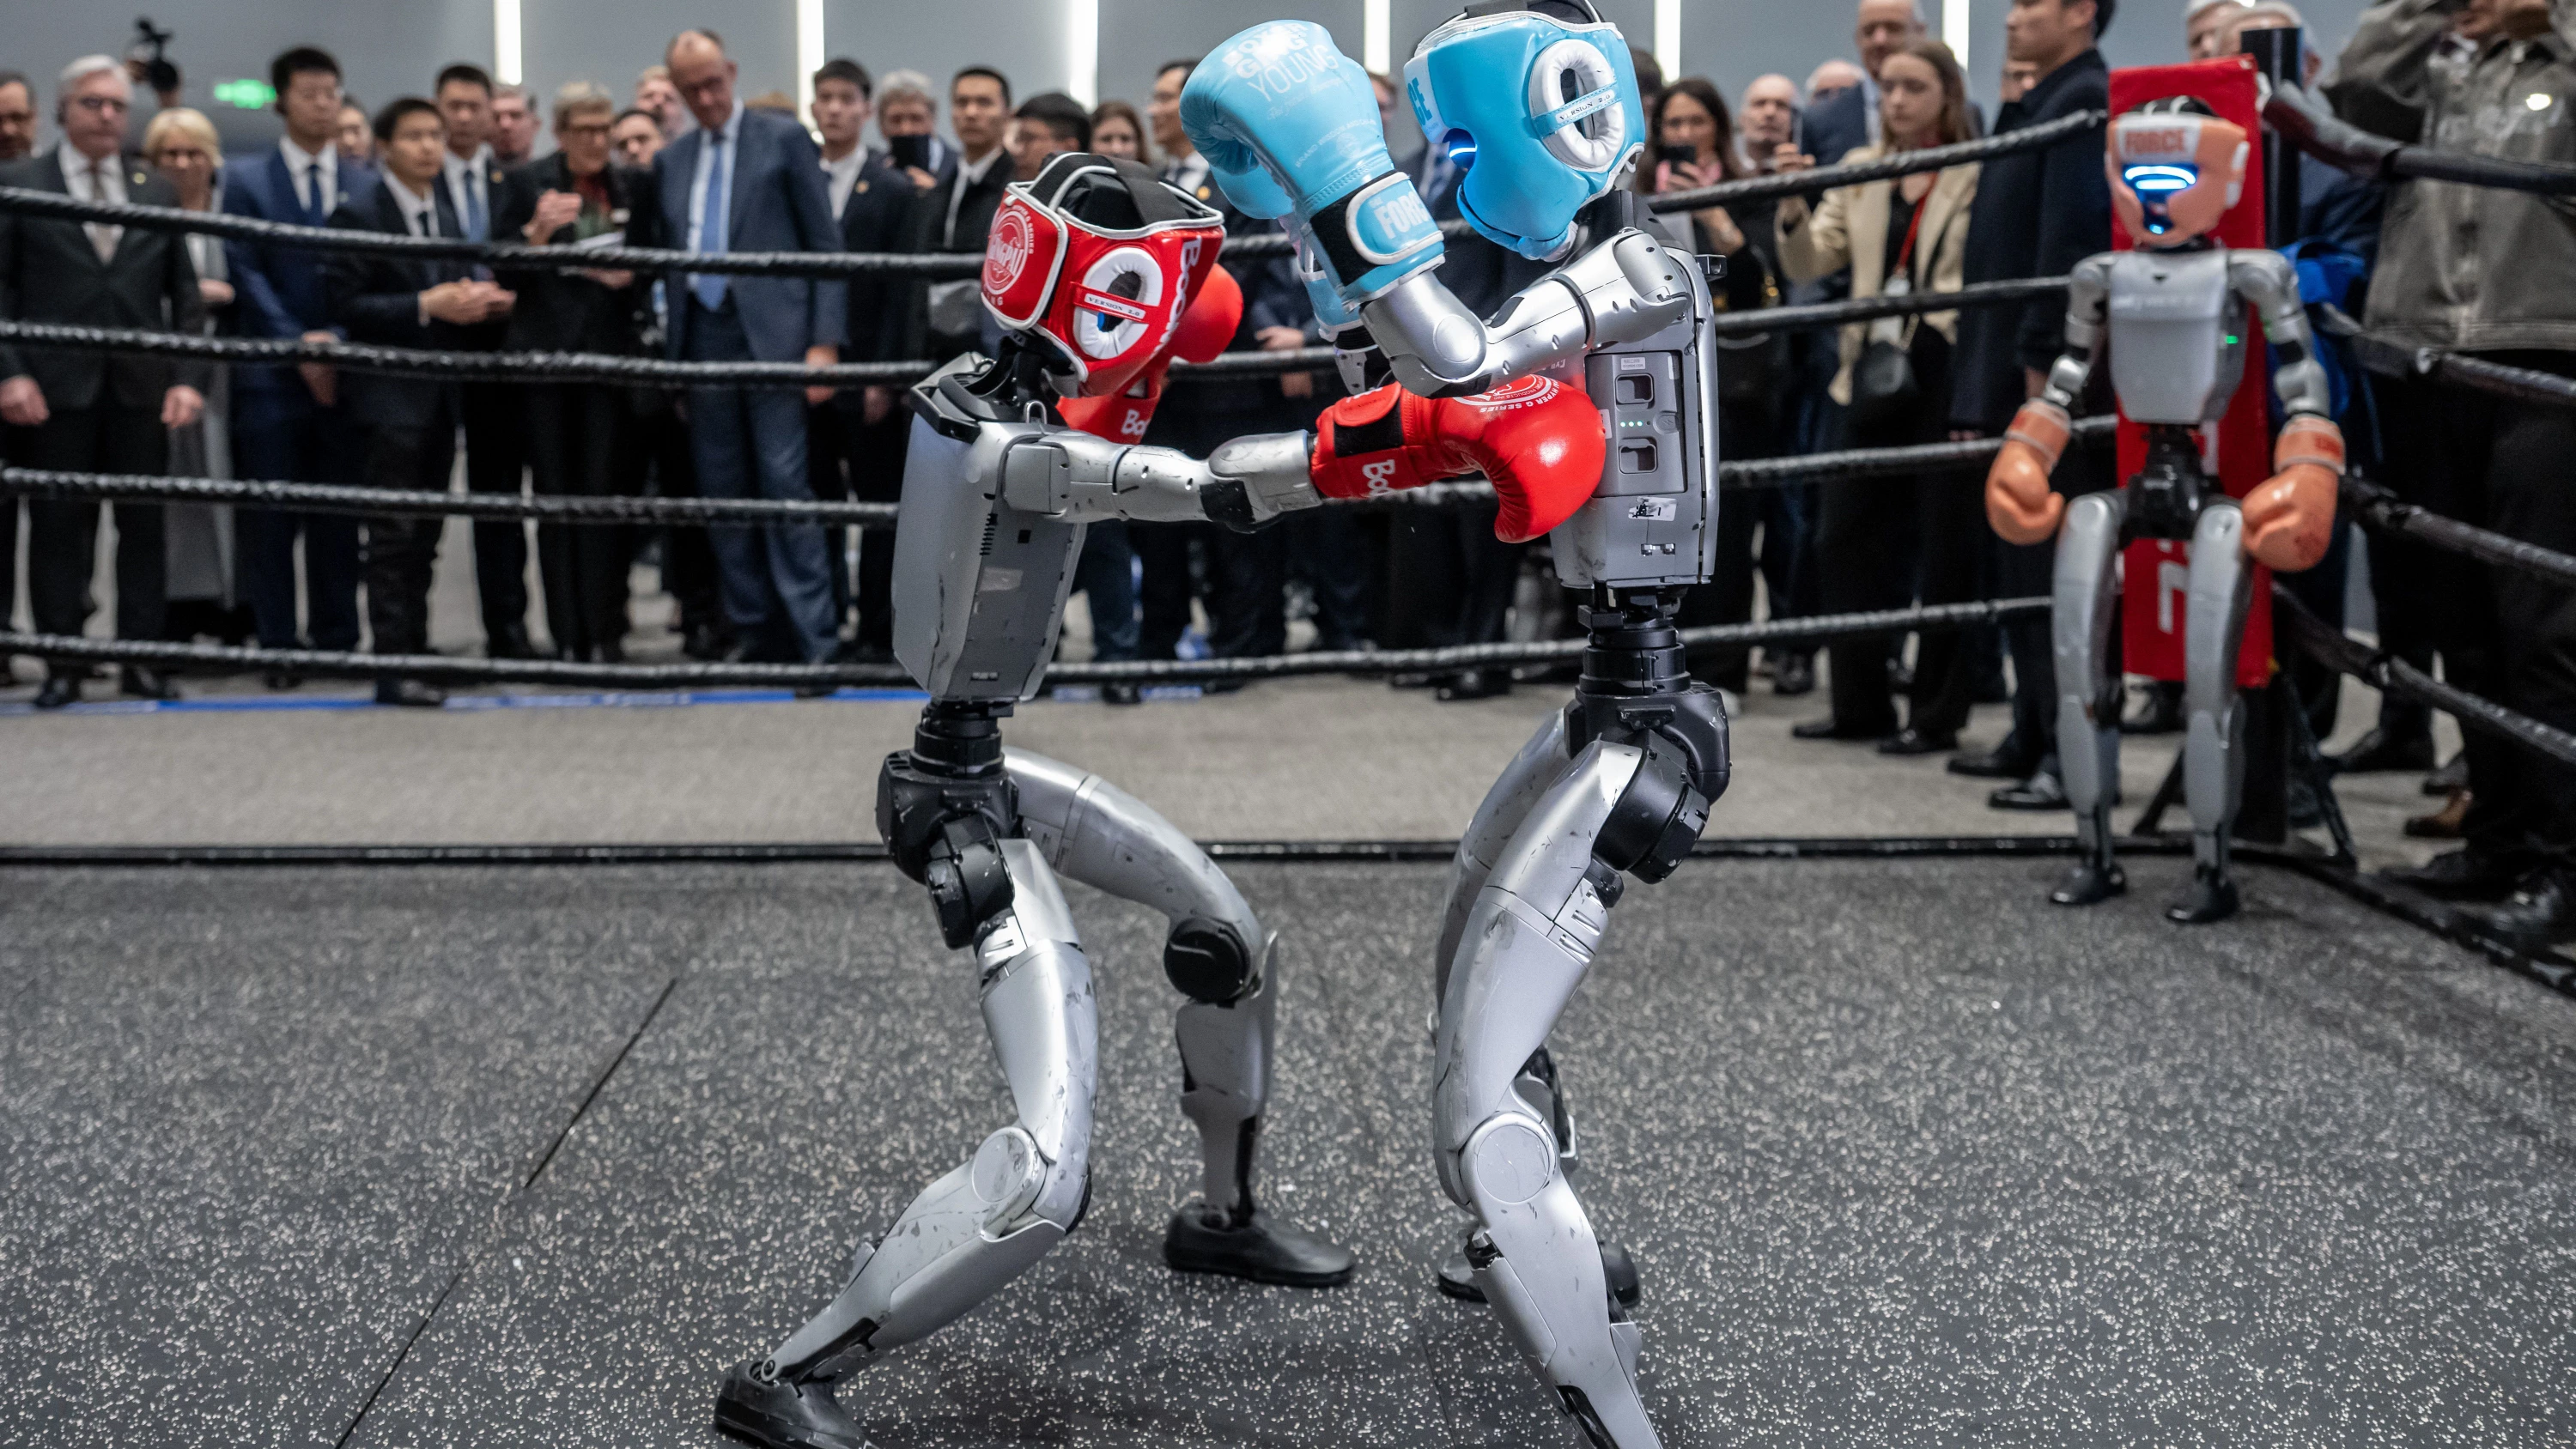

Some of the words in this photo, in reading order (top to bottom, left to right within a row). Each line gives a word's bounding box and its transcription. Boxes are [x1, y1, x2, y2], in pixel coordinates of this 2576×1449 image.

[1247, 44, 1340, 102] YOUNG
[1559, 101, 1594, 120] VRSION
[1374, 191, 1430, 239] FORC
[1088, 296, 1123, 311] VERSION
[1536, 387, 1559, 404] HYPER
[1480, 403, 1522, 412] SERIES
[1121, 408, 1151, 436] Bo
